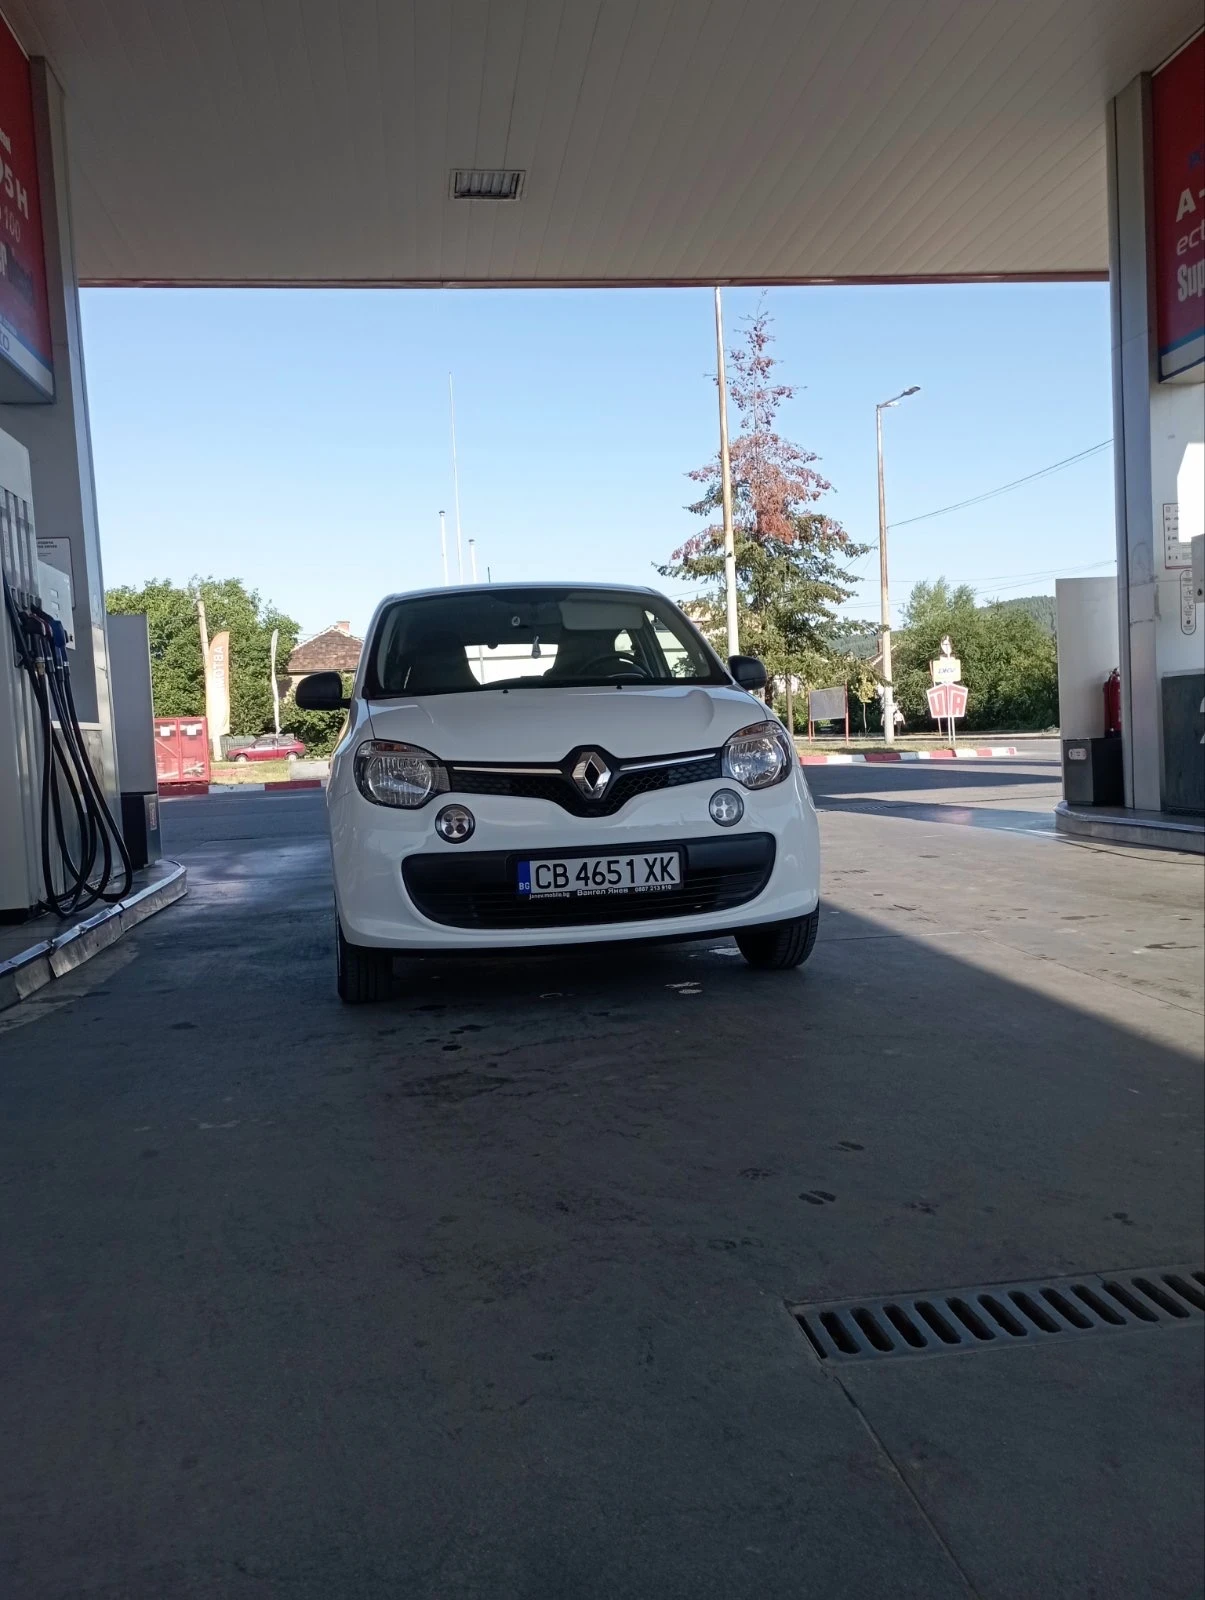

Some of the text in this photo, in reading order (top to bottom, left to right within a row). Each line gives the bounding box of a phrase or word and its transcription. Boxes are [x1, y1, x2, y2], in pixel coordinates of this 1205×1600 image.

[535, 856, 676, 889] CB 4651 XK
[519, 881, 530, 891] BG
